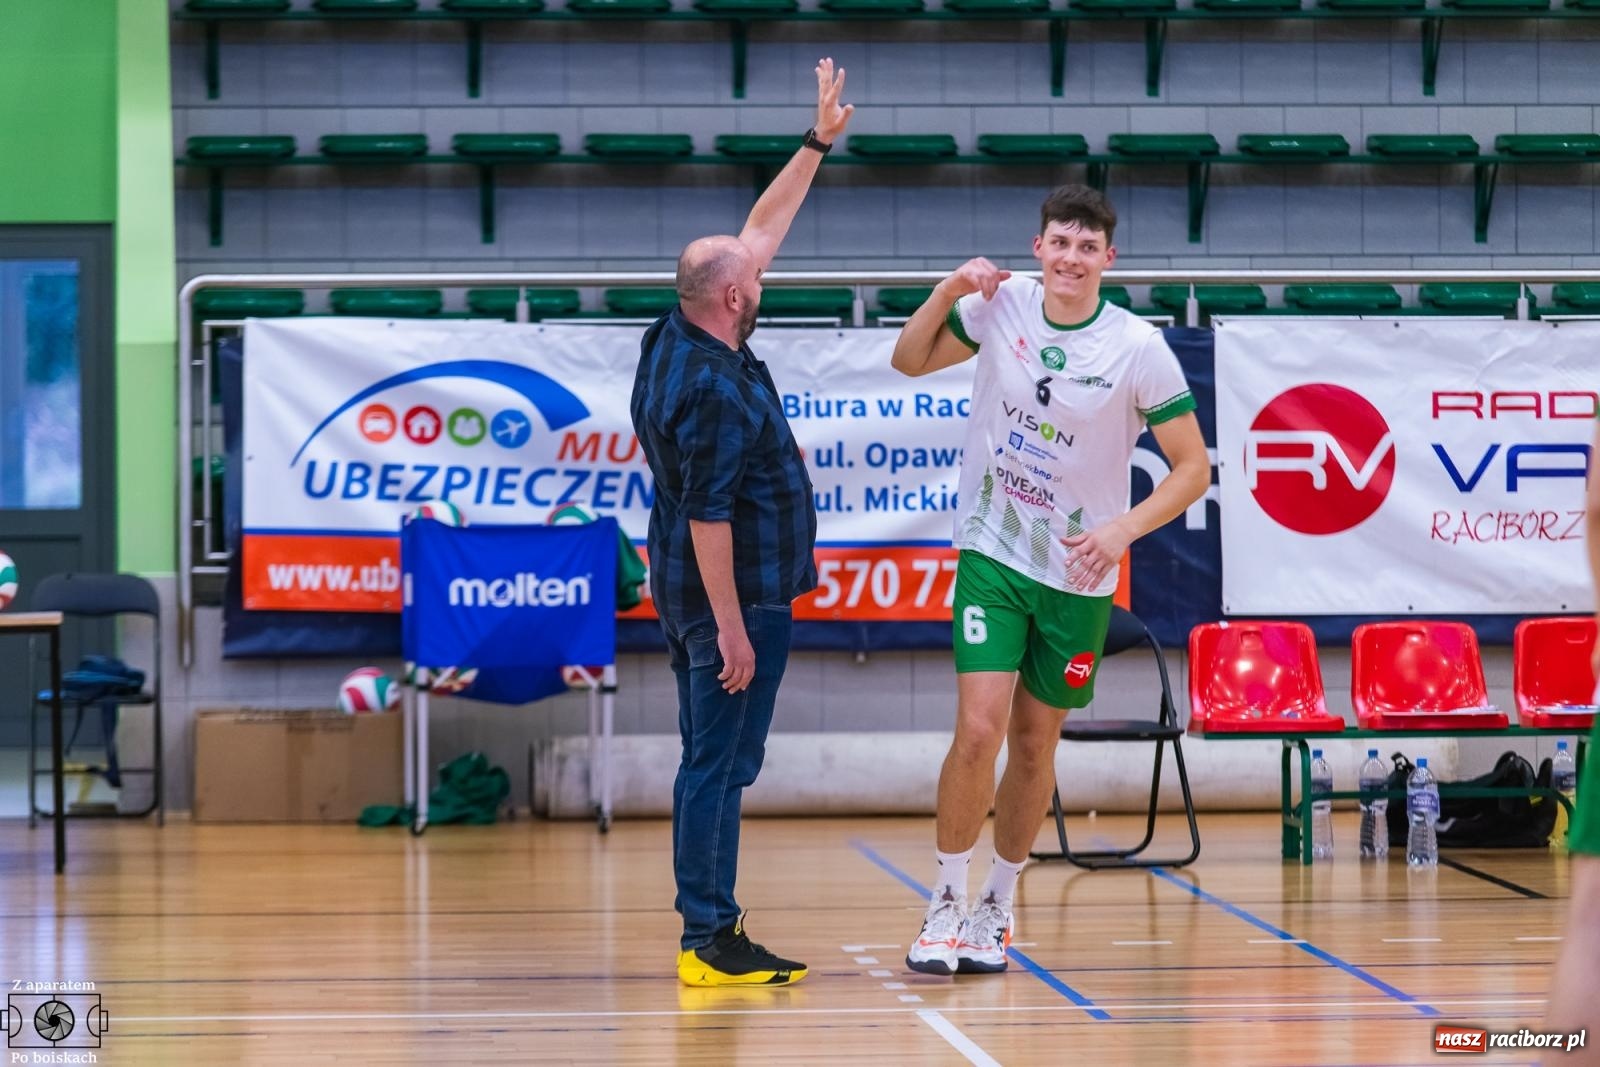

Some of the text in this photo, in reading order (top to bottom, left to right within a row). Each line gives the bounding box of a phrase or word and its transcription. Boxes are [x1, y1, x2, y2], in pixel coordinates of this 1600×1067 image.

[783, 393, 867, 419] Biura
[879, 399, 903, 418] w
[1035, 376, 1054, 407] 6
[557, 432, 649, 464] MU
[815, 441, 854, 468] ul.
[1248, 430, 1394, 492] RV
[815, 485, 853, 512] ul.
[267, 557, 401, 592] www.ub
[448, 571, 591, 608] molten
[815, 558, 901, 609] 570
[962, 604, 988, 645] 6
